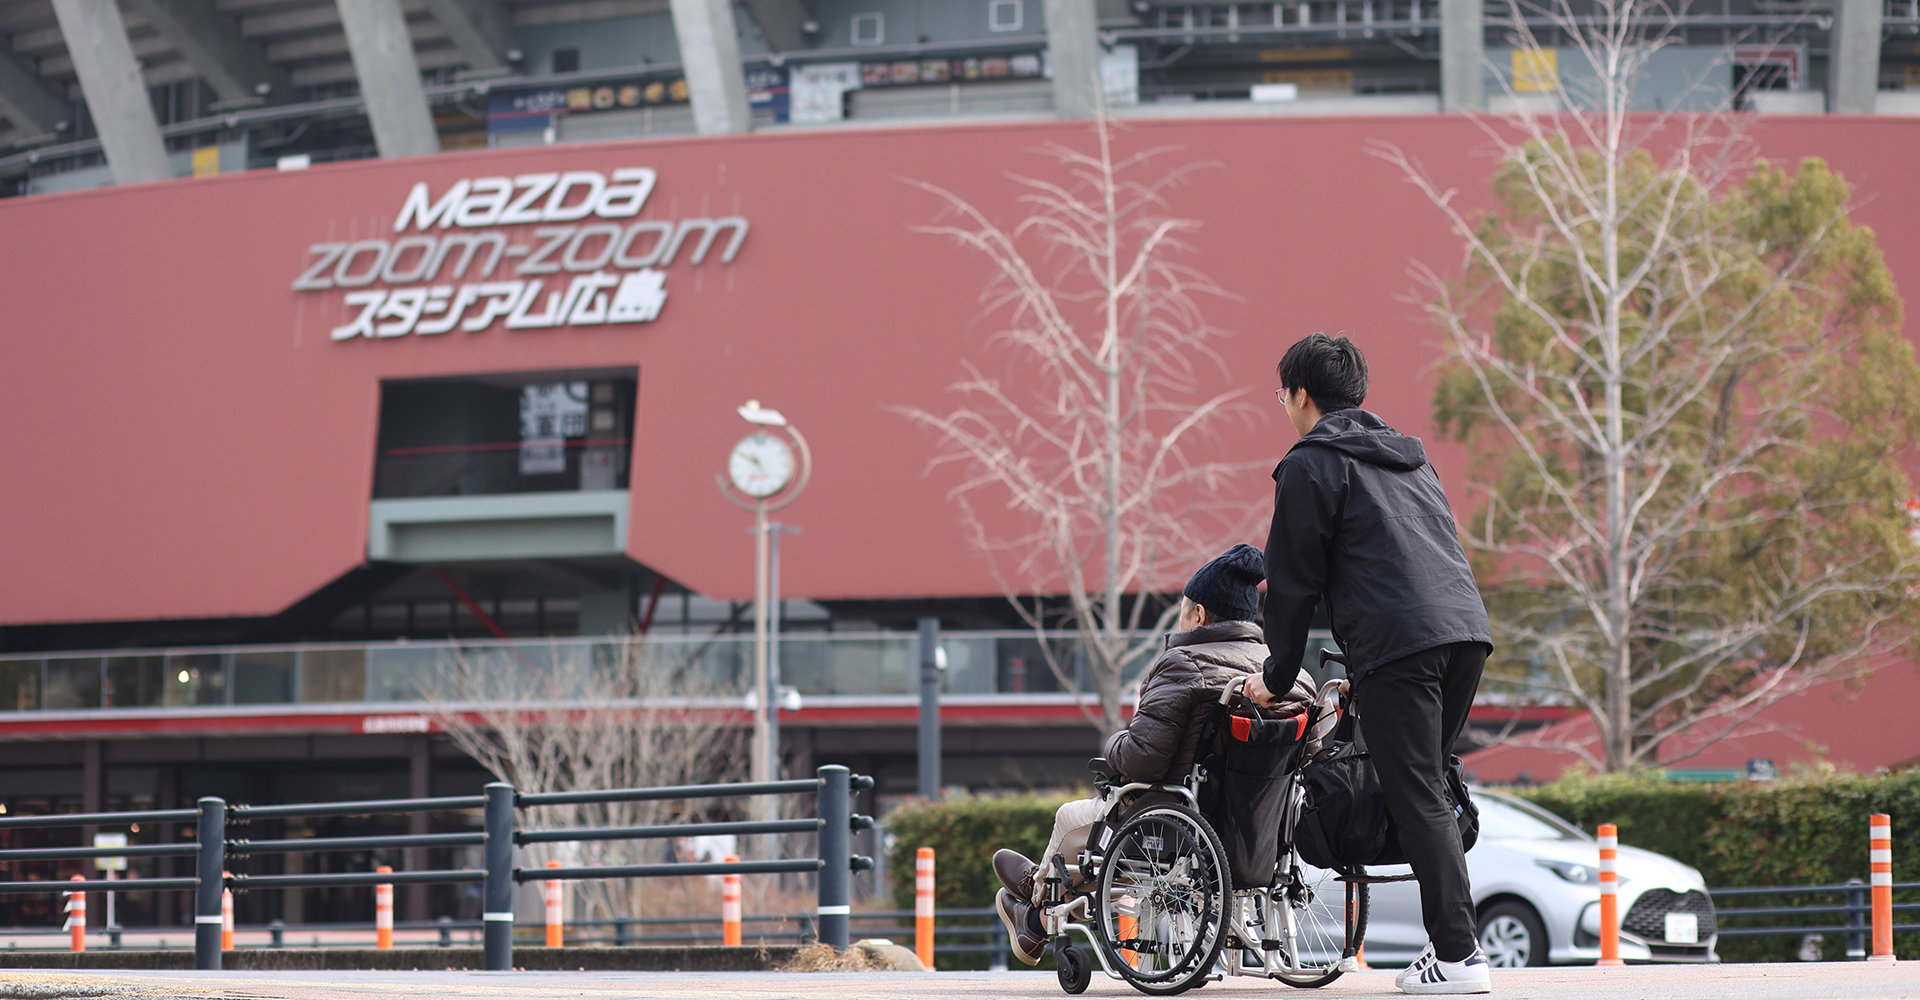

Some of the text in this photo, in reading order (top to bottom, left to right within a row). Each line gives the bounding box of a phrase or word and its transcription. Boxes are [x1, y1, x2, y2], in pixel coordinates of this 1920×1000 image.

[331, 268, 668, 340] スタジアム広島
